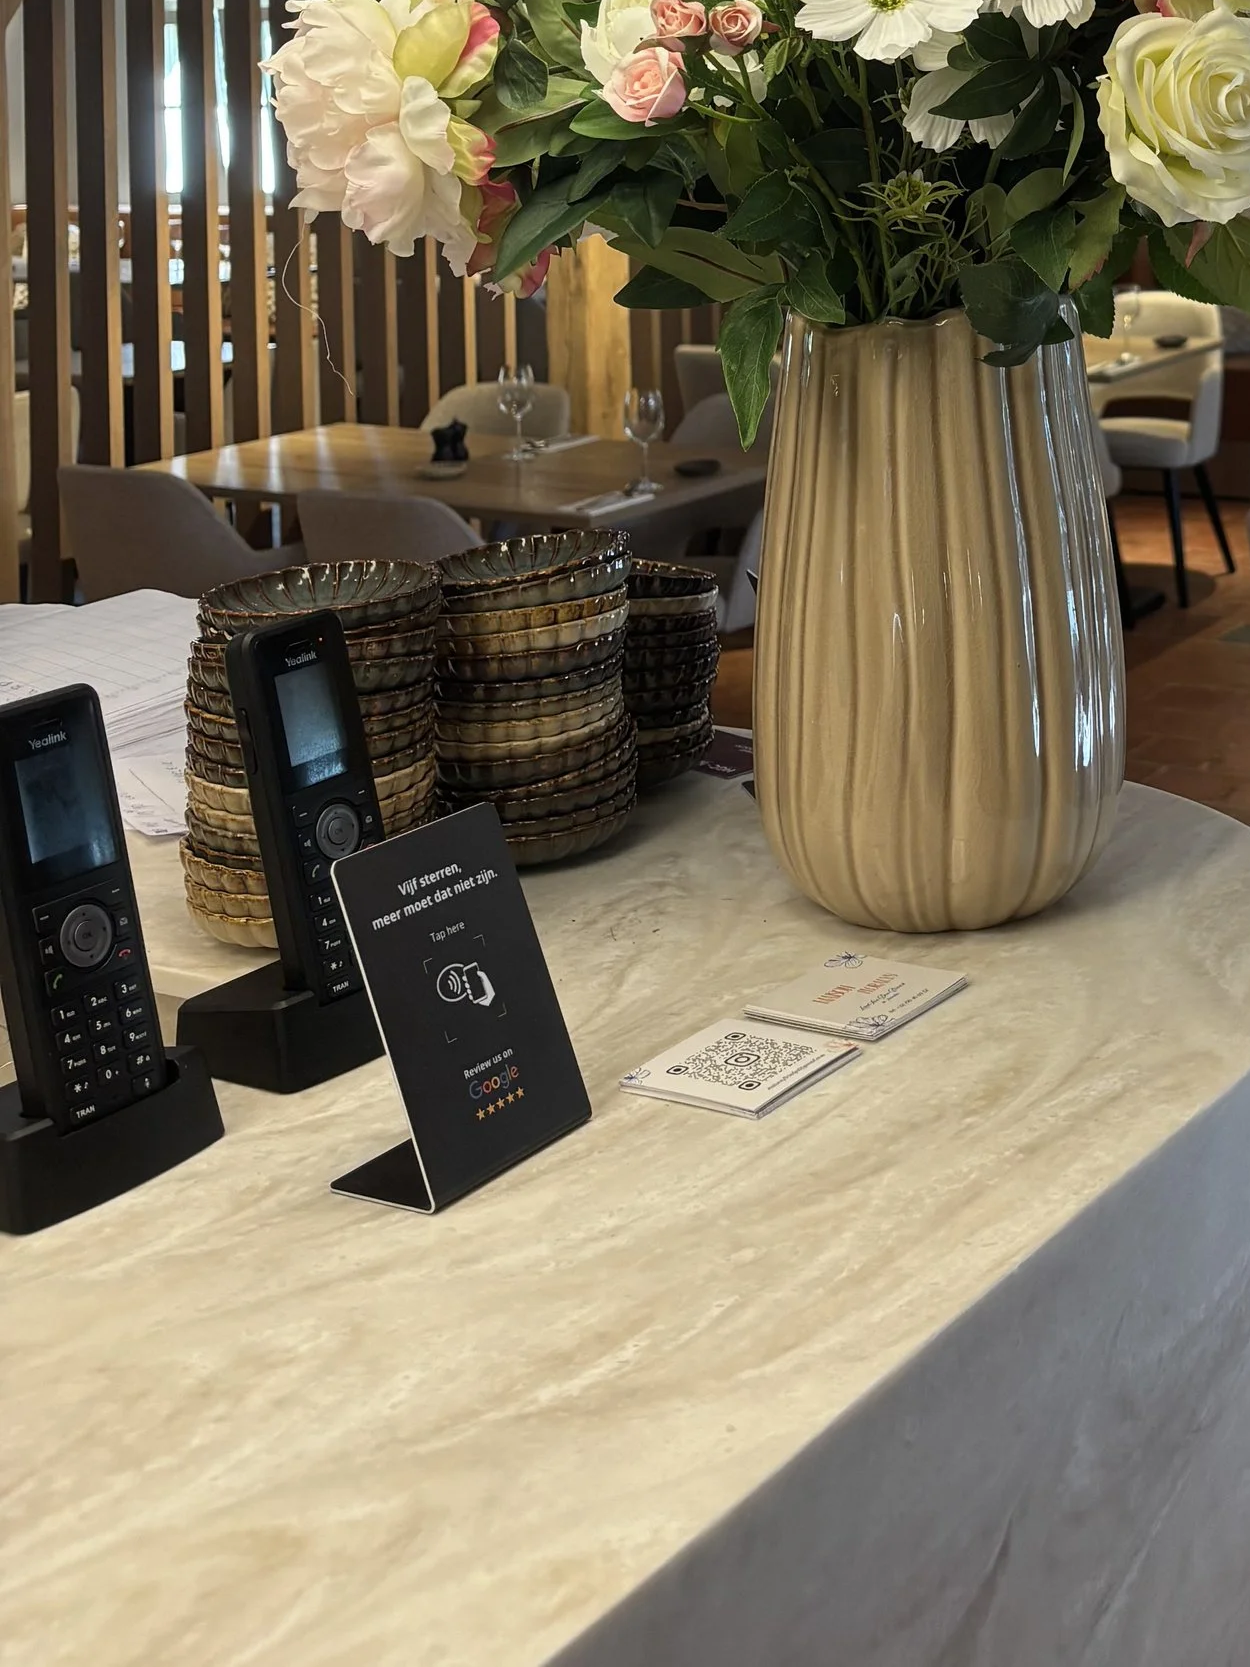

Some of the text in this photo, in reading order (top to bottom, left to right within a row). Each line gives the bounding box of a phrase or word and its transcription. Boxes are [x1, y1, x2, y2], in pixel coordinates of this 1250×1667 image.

[285, 650, 317, 667] Yealink
[28, 731, 67, 750] Yealink
[397, 863, 462, 896] Vijf sterren,
[317, 896, 323, 906] 1
[372, 869, 498, 931] meer moet dat niet zijn.
[322, 917, 328, 927] 4
[429, 920, 465, 943] Tap here
[324, 940, 330, 950] 7
[121, 984, 127, 994] 3
[332, 980, 350, 993] TRAN
[90, 997, 97, 1007] 2
[59, 1010, 65, 1020] 1
[125, 1008, 132, 1018] 6
[95, 1021, 102, 1031] 5
[64, 1033, 71, 1044] 4
[129, 1032, 135, 1042] 9
[100, 1045, 106, 1055] 8
[67, 1059, 73, 1070] 7
[463, 1048, 513, 1080] Review us on
[105, 1069, 112, 1079] 0
[469, 1064, 519, 1100] Google
[76, 1104, 96, 1119] TRAN
